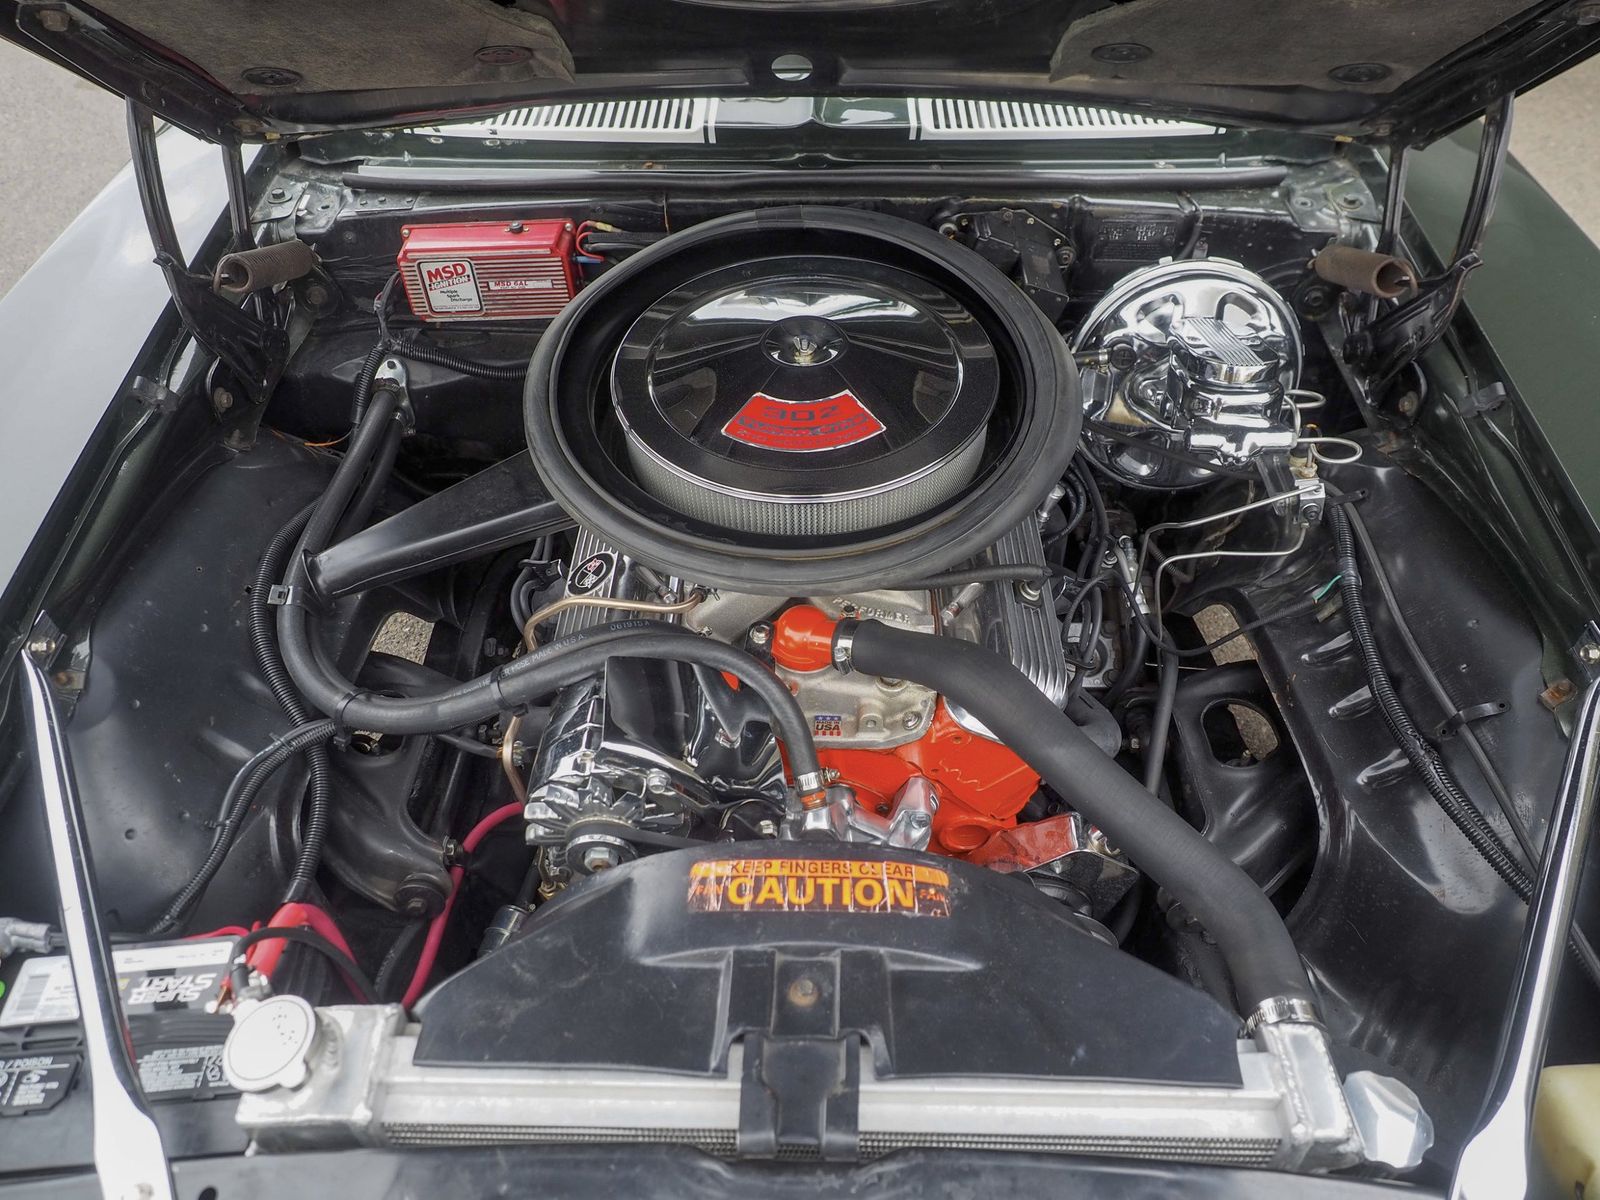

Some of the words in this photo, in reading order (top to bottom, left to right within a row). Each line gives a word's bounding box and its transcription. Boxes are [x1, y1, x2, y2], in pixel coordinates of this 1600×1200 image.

[427, 263, 466, 282] MSD
[431, 275, 468, 290] IGNITION
[763, 405, 838, 421] 302
[731, 861, 772, 874] KEEP
[779, 861, 852, 875] FINGERS
[859, 863, 914, 878] CLEAR
[727, 876, 914, 908] CAUTION
[138, 973, 217, 992] START
[128, 986, 201, 1005] SUPER
